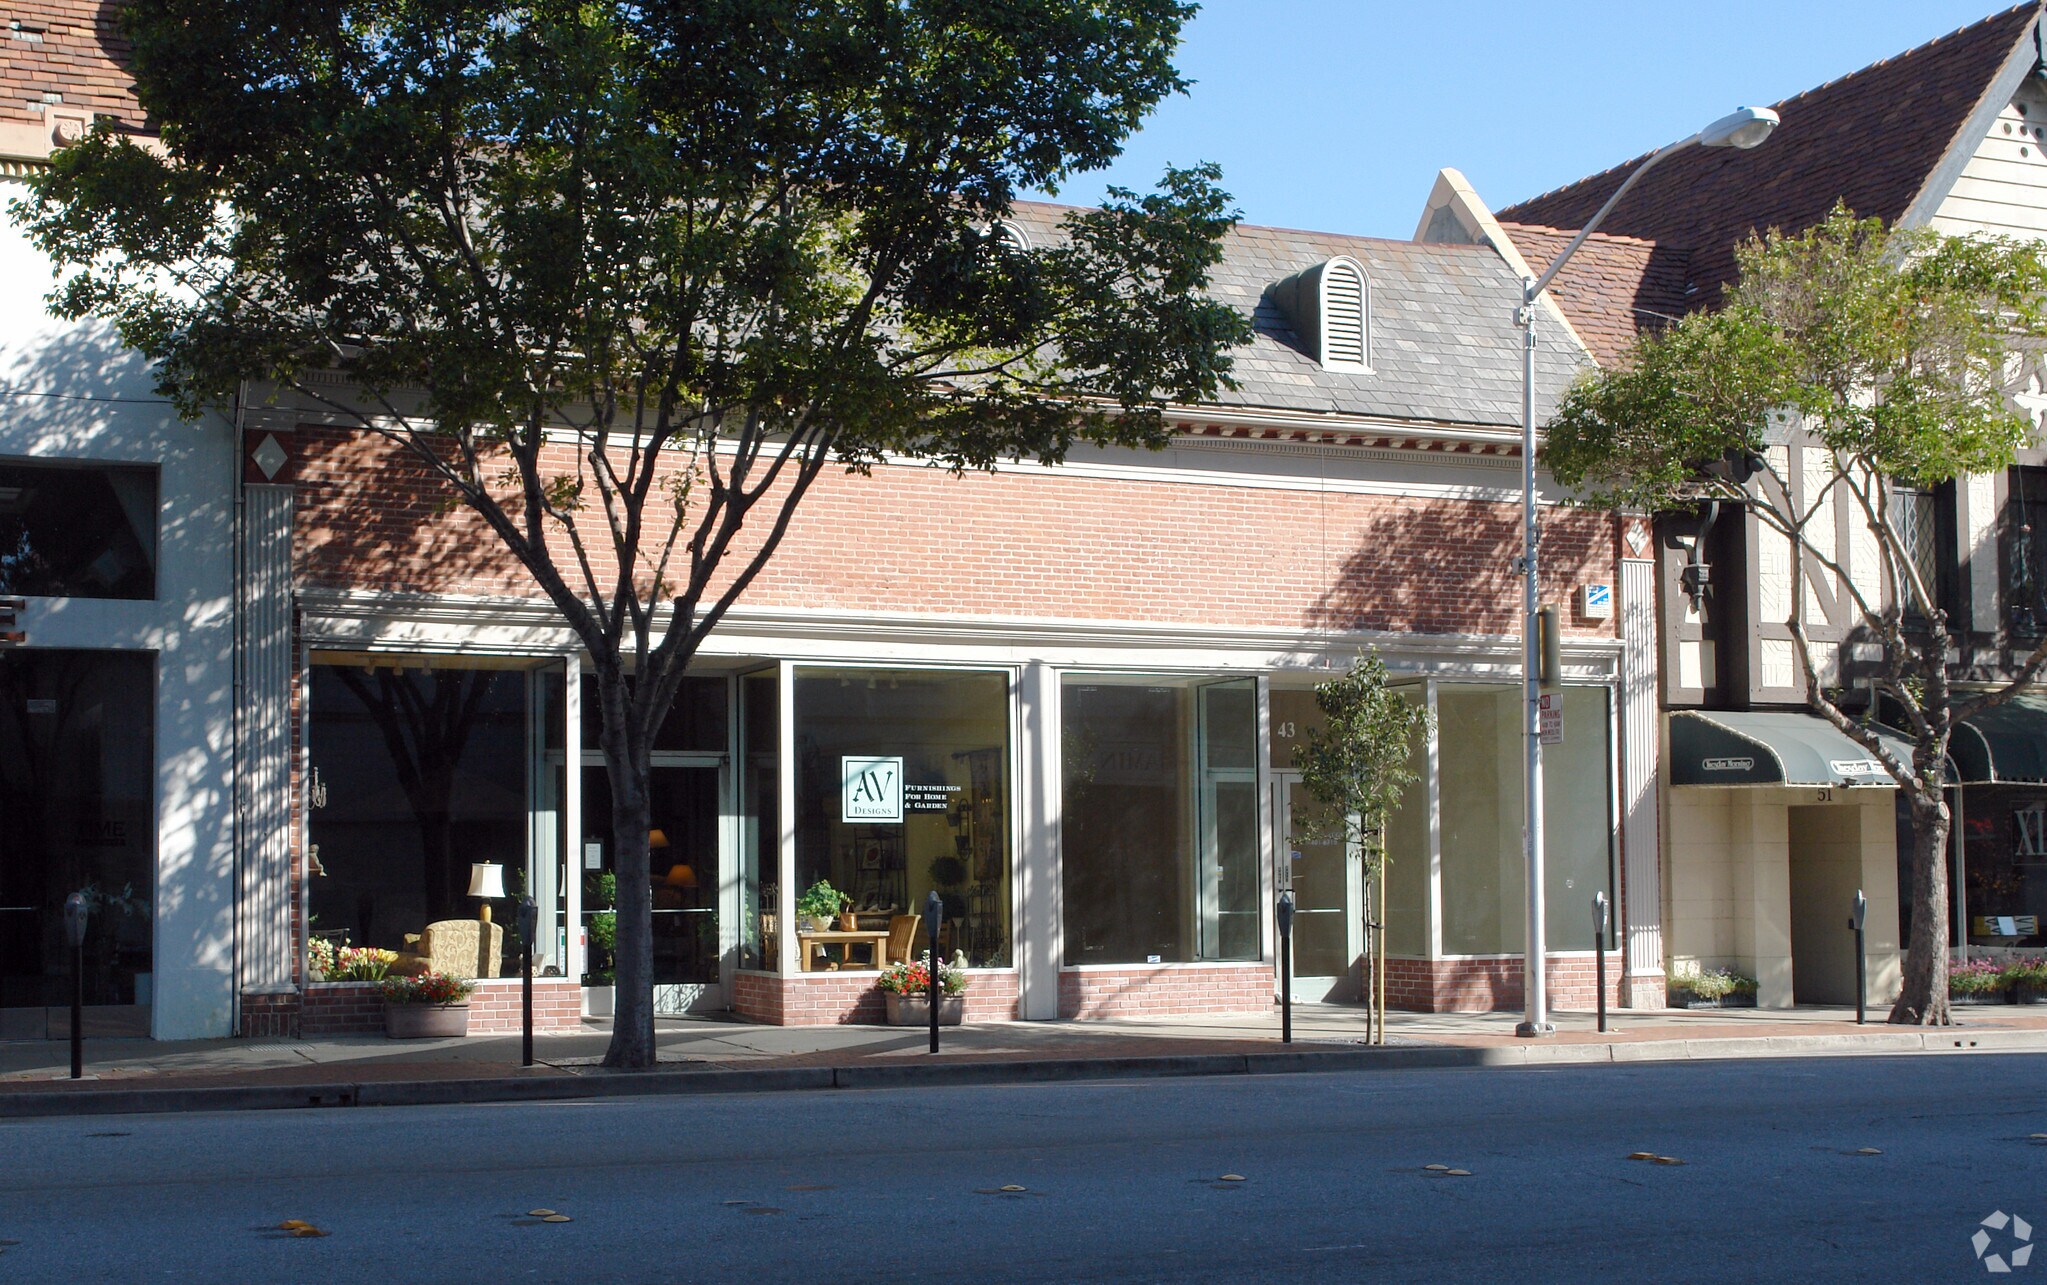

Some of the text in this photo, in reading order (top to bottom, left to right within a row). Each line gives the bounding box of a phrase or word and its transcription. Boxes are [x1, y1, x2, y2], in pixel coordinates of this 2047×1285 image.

[1541, 695, 1550, 709] NO
[1541, 709, 1561, 719] PARKING
[1277, 721, 1296, 738] 43
[852, 770, 893, 802] AV
[904, 784, 962, 792] FURNISHINGS
[1817, 787, 1832, 802] 51
[854, 806, 892, 815] DESIGNS
